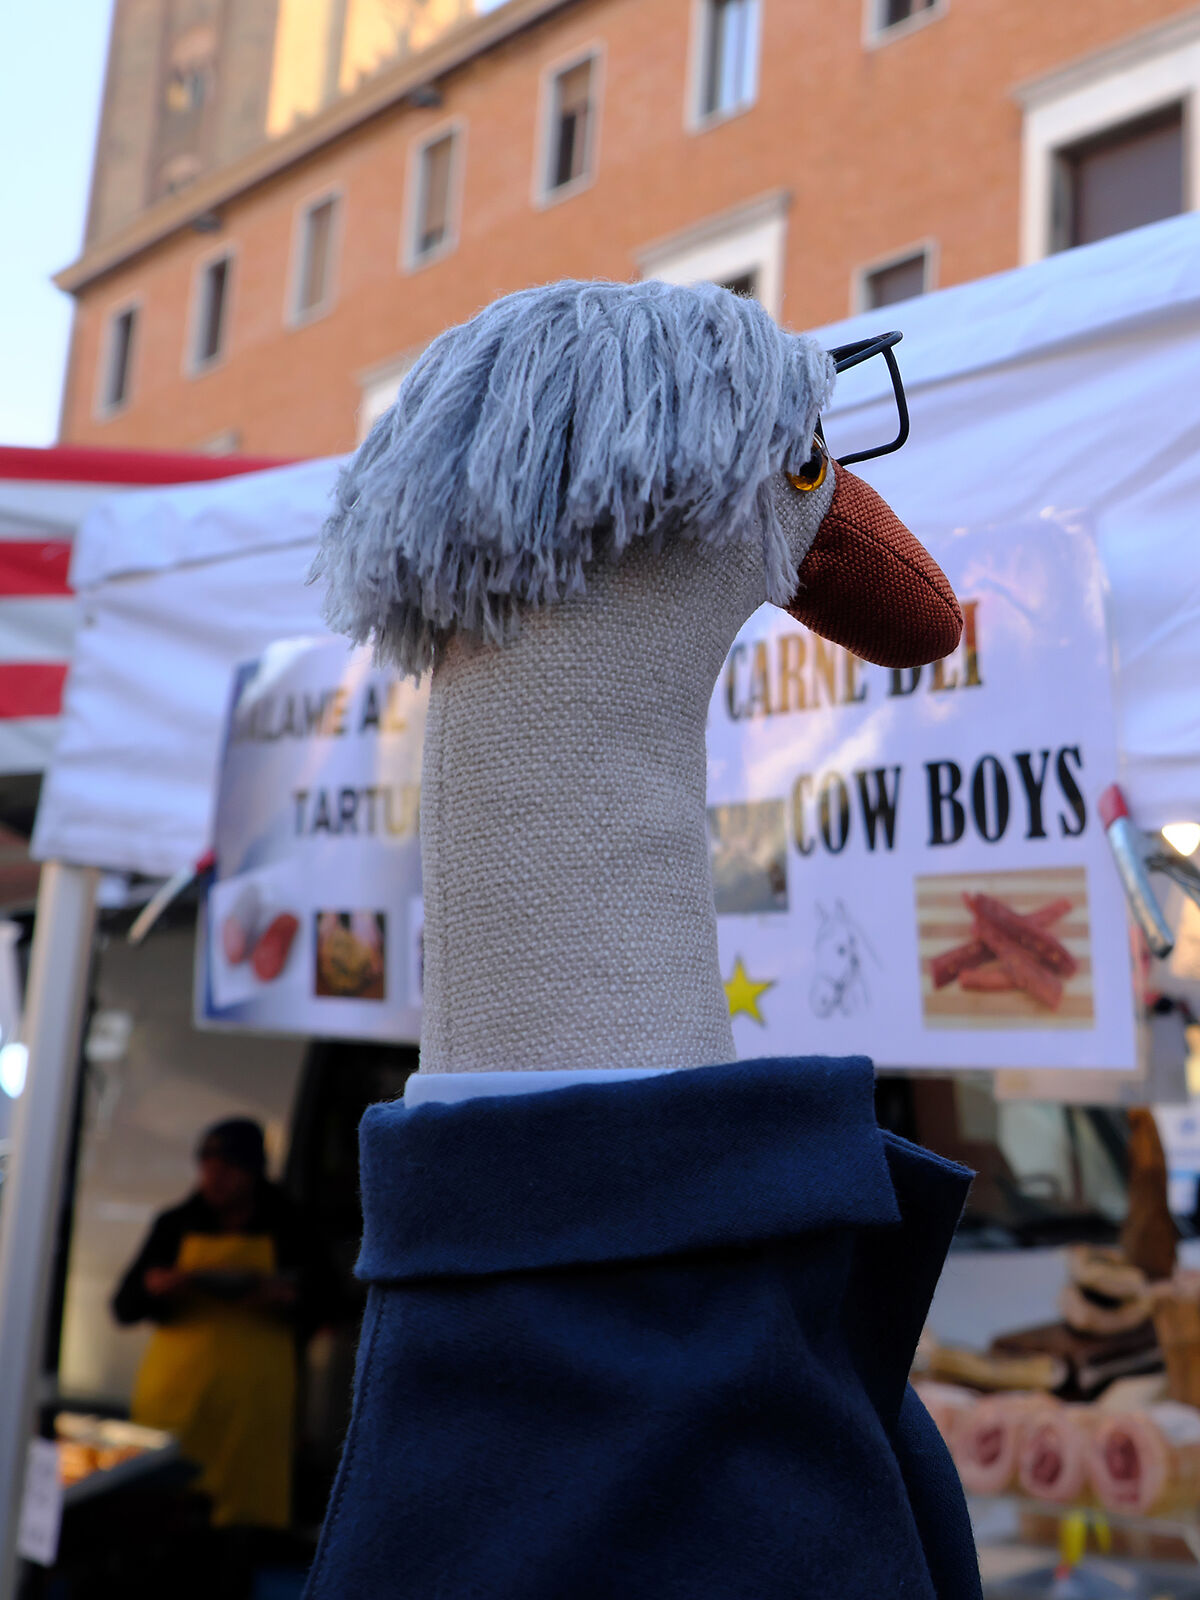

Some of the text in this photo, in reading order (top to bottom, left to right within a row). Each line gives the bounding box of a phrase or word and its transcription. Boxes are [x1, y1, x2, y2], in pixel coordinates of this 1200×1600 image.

[724, 630, 868, 722] CARNE
[293, 784, 421, 838] TARTU
[790, 743, 1088, 858] COW BOYS
